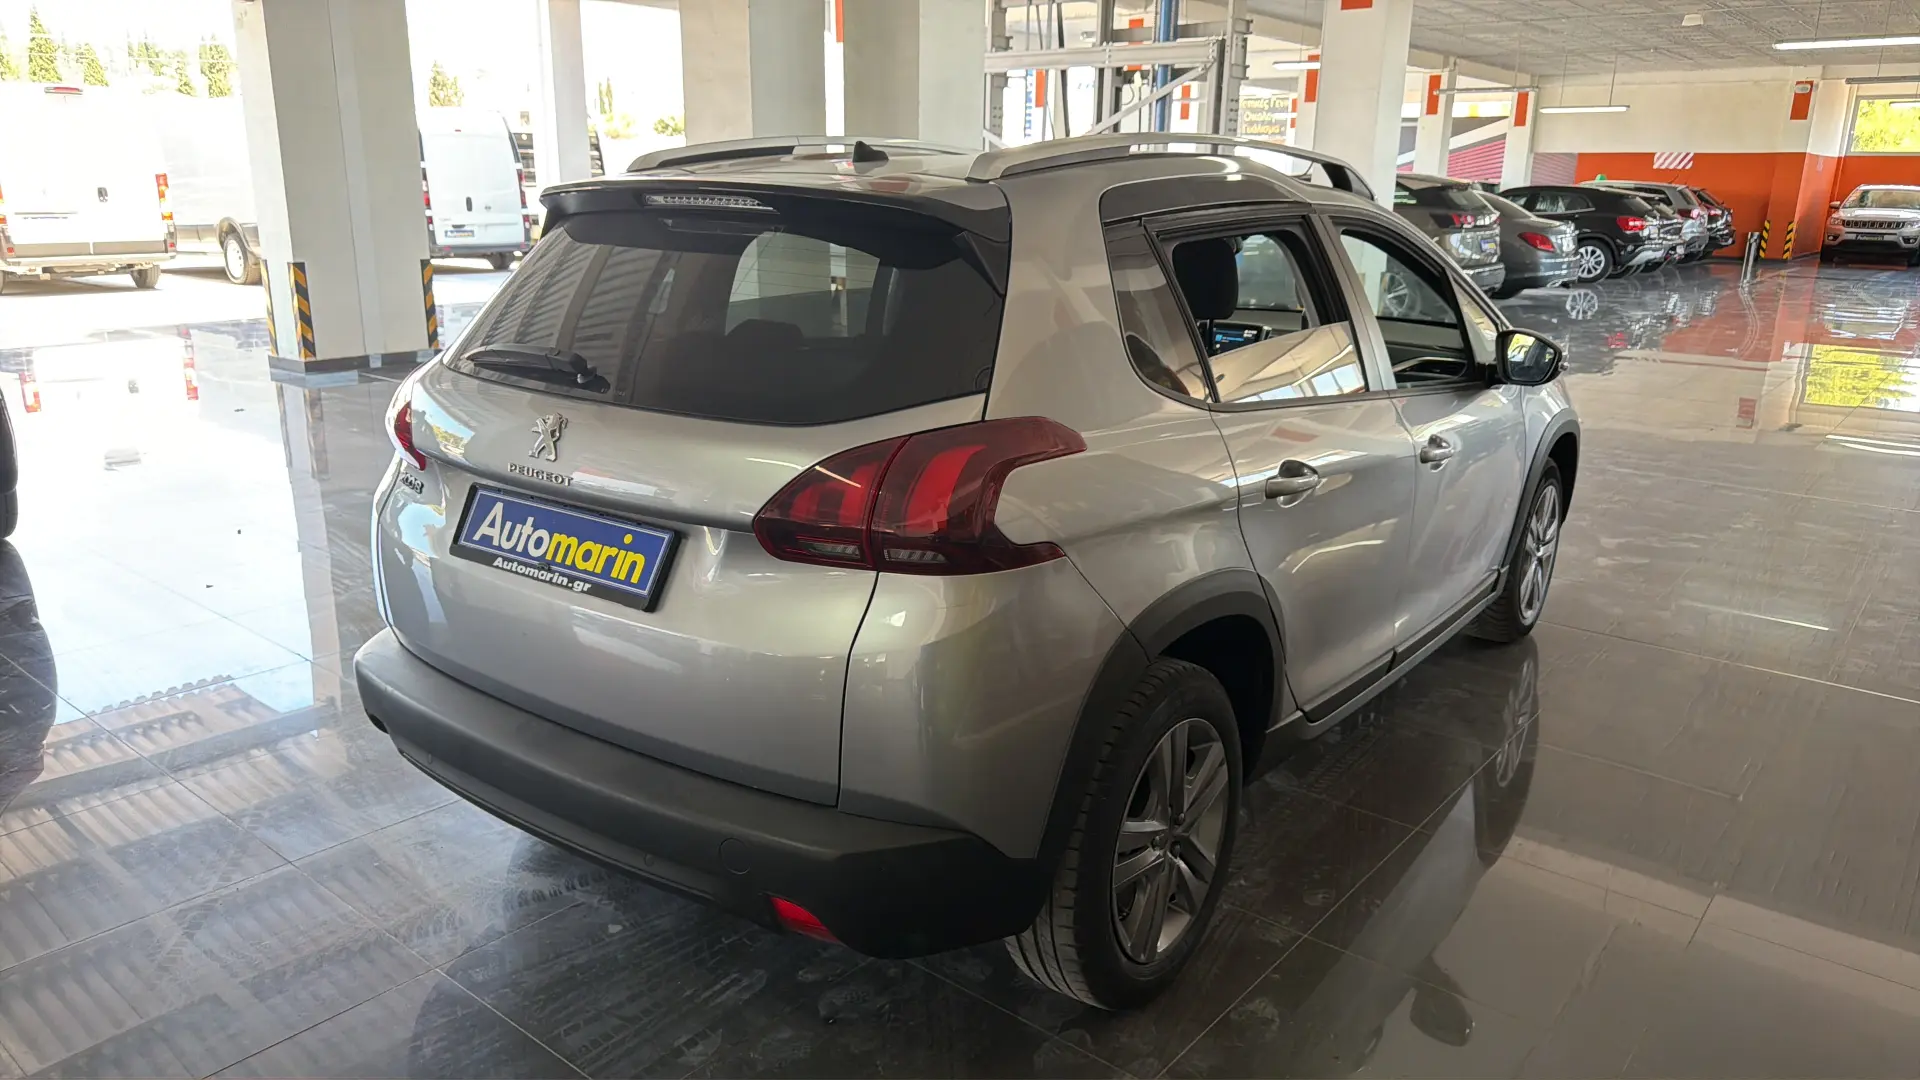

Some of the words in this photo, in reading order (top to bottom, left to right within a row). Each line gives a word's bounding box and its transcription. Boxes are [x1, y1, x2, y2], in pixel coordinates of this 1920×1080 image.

[507, 462, 573, 487] PEUGEOT
[473, 502, 645, 584] Automarin
[493, 557, 591, 593] Automarin.gr
